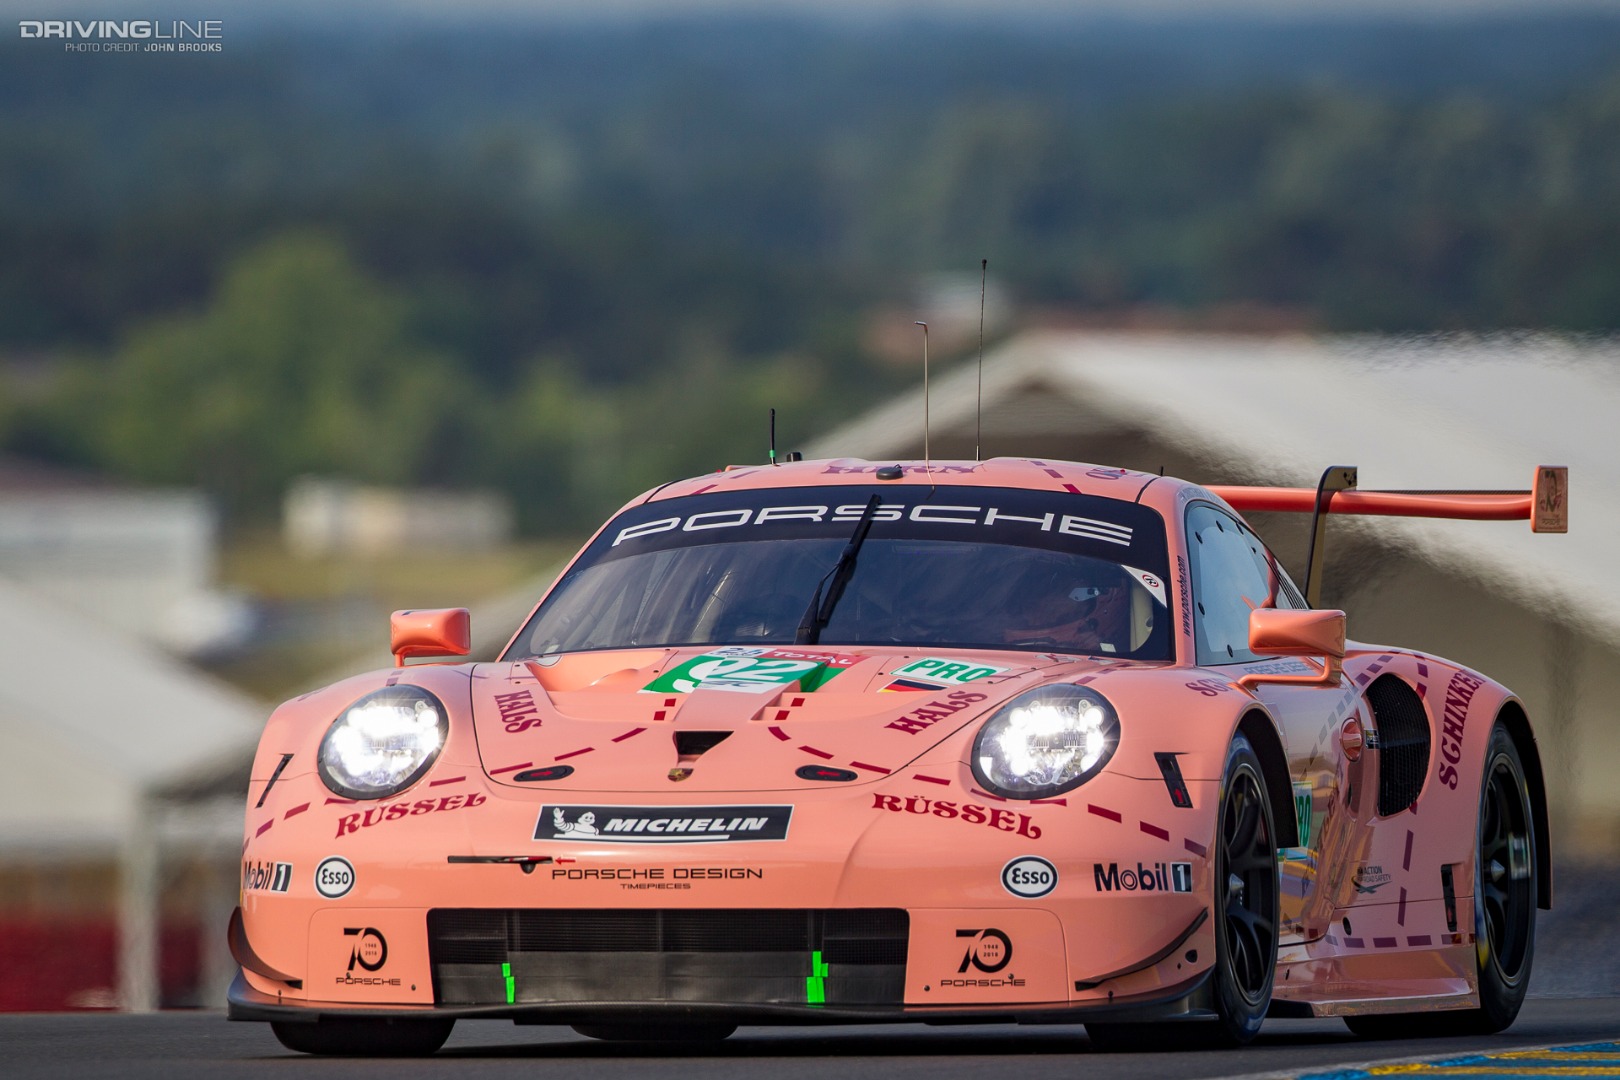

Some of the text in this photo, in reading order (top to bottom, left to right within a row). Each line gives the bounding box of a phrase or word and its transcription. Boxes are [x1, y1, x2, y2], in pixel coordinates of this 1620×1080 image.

[611, 504, 1134, 547] PORSCHE
[773, 651, 853, 665] TOTAL
[902, 658, 997, 683] PRO
[493, 689, 543, 734] HALS
[883, 690, 988, 736] HALS
[603, 816, 768, 832] MICHELIN
[872, 792, 1043, 840] RÜSSEL
[321, 868, 350, 885] Esso
[552, 867, 763, 880] PORSCHE DESIGN
[1011, 867, 1050, 885] Esso
[1093, 862, 1169, 892] Mobil
[343, 927, 388, 972] 70
[955, 928, 1013, 974] 70
[335, 977, 402, 986] PORSCHE
[941, 979, 1026, 987] PORSCHE
